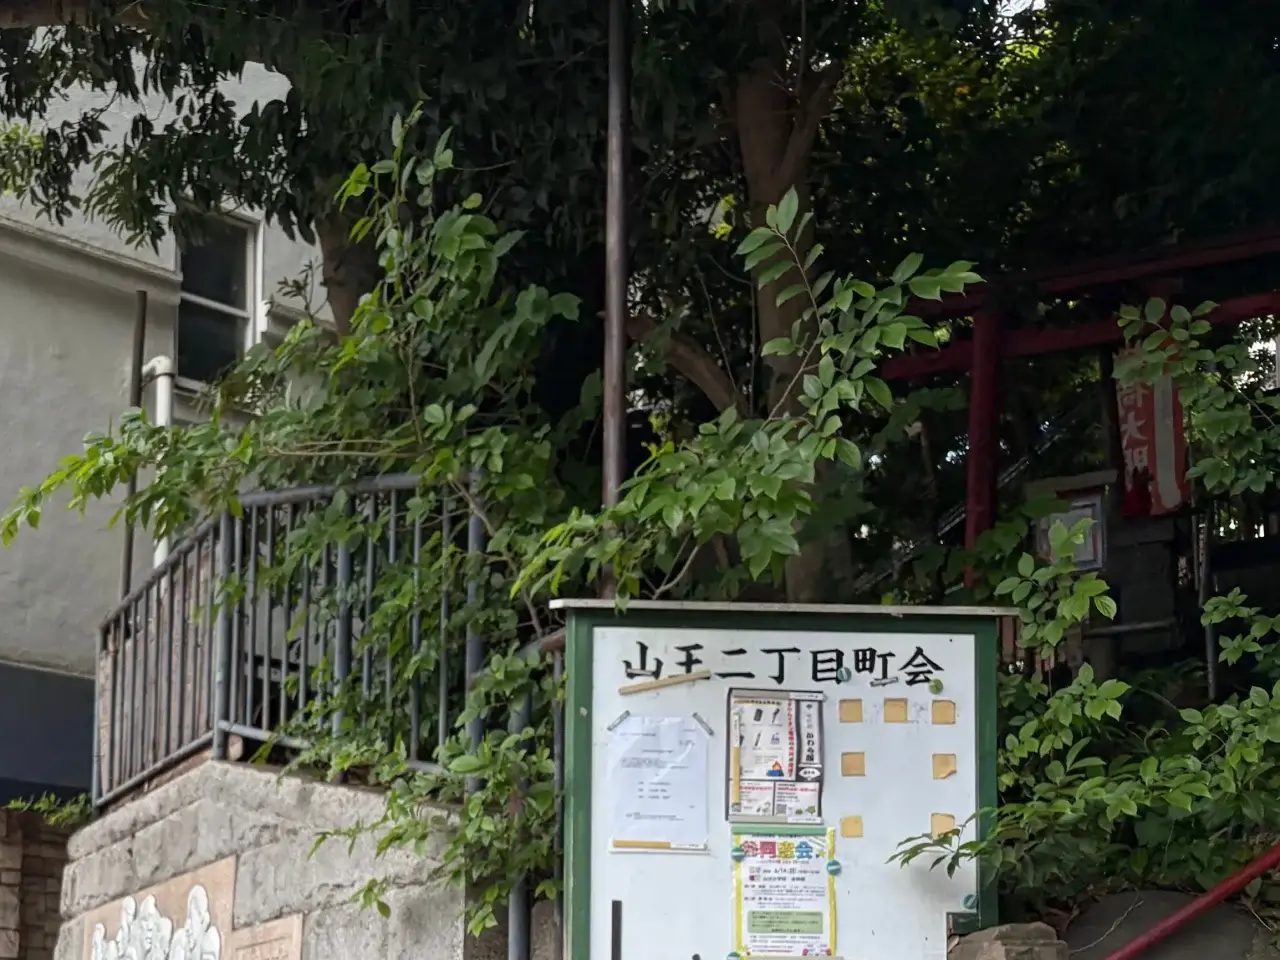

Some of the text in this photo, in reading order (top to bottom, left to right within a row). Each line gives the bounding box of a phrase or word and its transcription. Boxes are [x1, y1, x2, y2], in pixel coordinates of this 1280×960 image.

[623, 641, 945, 686] 山王二丁目町会
